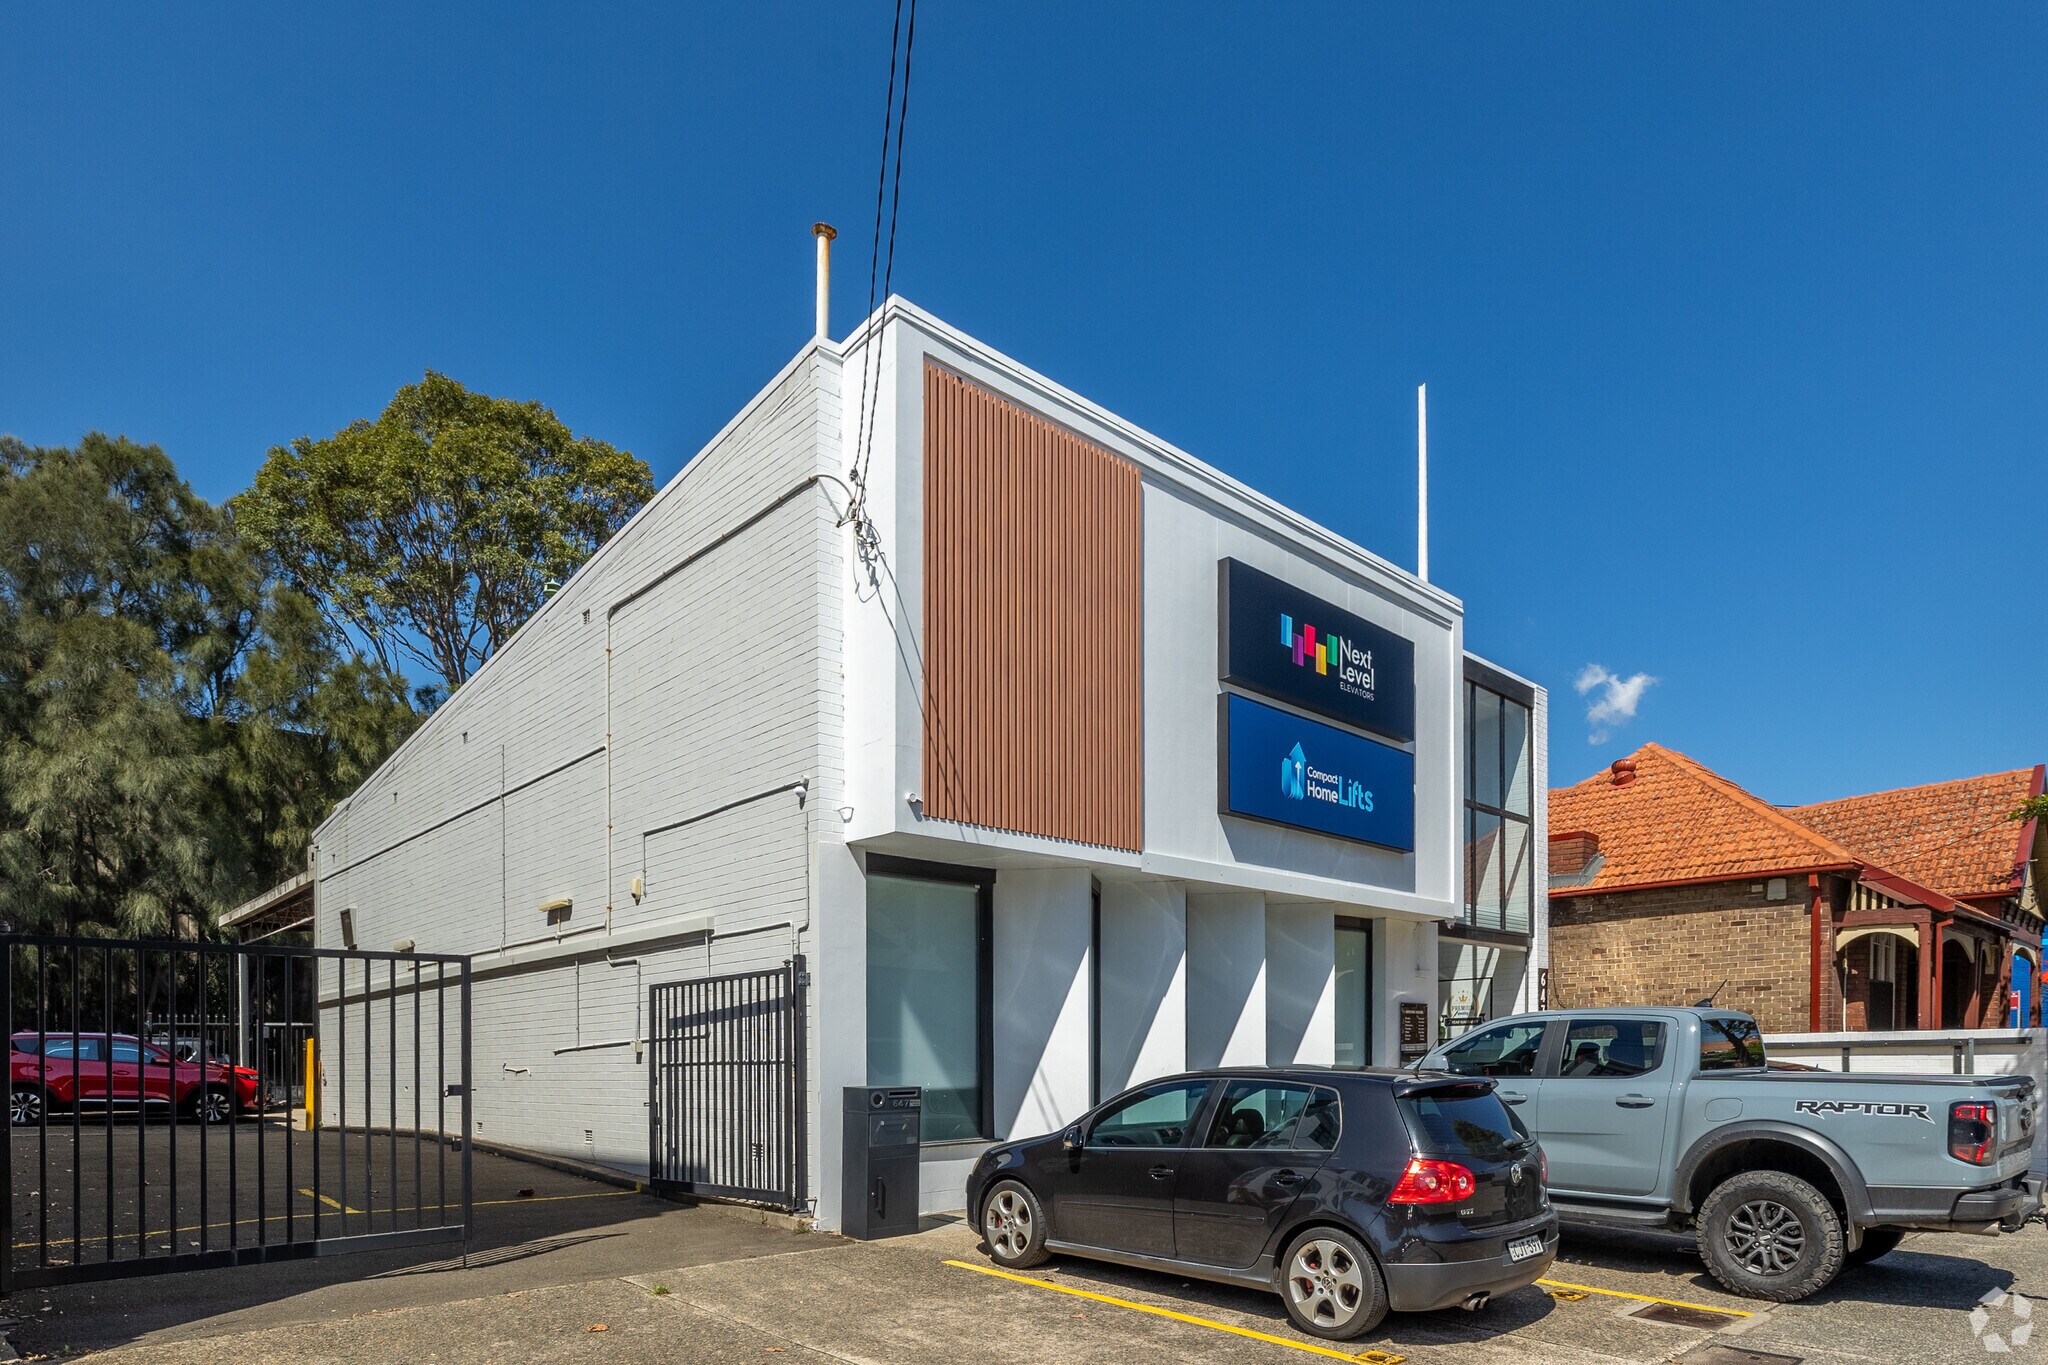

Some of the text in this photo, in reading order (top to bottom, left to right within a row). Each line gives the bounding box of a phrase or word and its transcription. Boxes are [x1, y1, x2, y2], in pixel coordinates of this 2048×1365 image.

[1340, 635, 1372, 670] Next
[1340, 666, 1375, 691] Level
[1340, 681, 1375, 702] ELEVATORS
[1307, 766, 1339, 784] Compact
[893, 1099, 910, 1108] 647
[1794, 1099, 1936, 1125] RAPTOR
[1460, 1207, 1475, 1216] GTI
